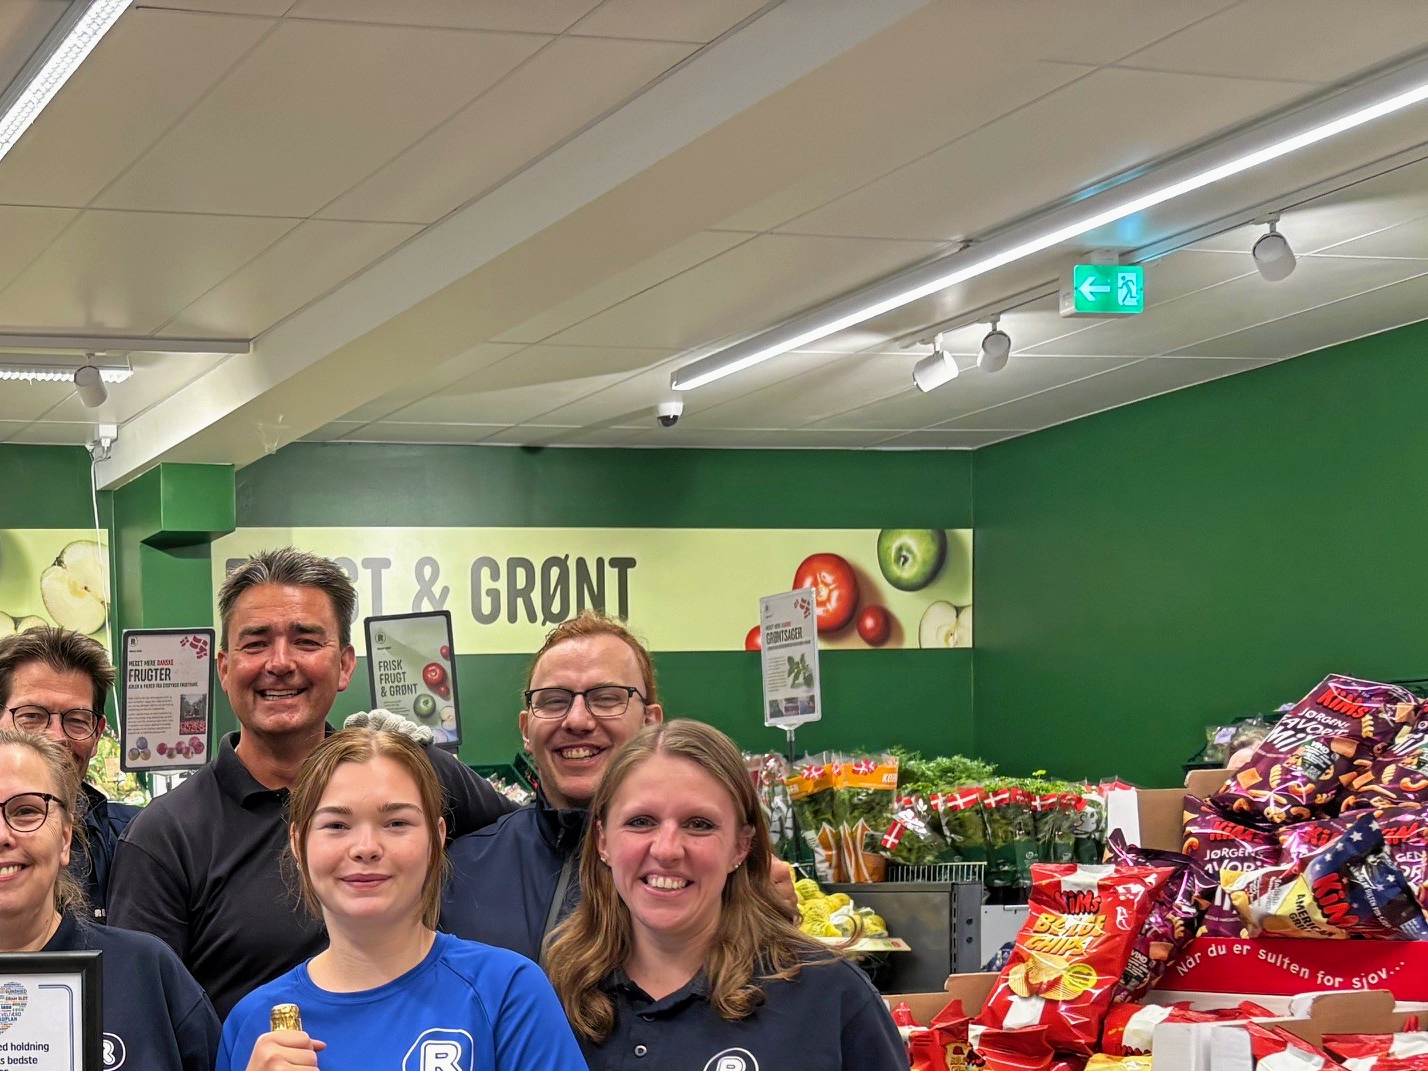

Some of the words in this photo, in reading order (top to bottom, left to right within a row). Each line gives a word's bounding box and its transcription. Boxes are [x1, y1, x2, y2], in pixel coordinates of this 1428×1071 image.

[471, 553, 637, 627] GRØNT
[766, 627, 802, 645] GRØNTSAGER
[378, 660, 402, 672] FRISK
[128, 668, 171, 682] FRUGTER
[380, 672, 406, 684] FRUGT
[380, 687, 387, 697] &
[390, 684, 418, 696] GRØNT
[1204, 849, 1264, 861] JØRGENS
[1176, 951, 1202, 976] Når
[1207, 944, 1227, 958] du
[1233, 943, 1251, 955] er
[1257, 948, 1310, 979] sulten
[1316, 970, 1344, 988] for
[10, 1042, 50, 1052] holdning
[8, 1056, 38, 1065] bedste
